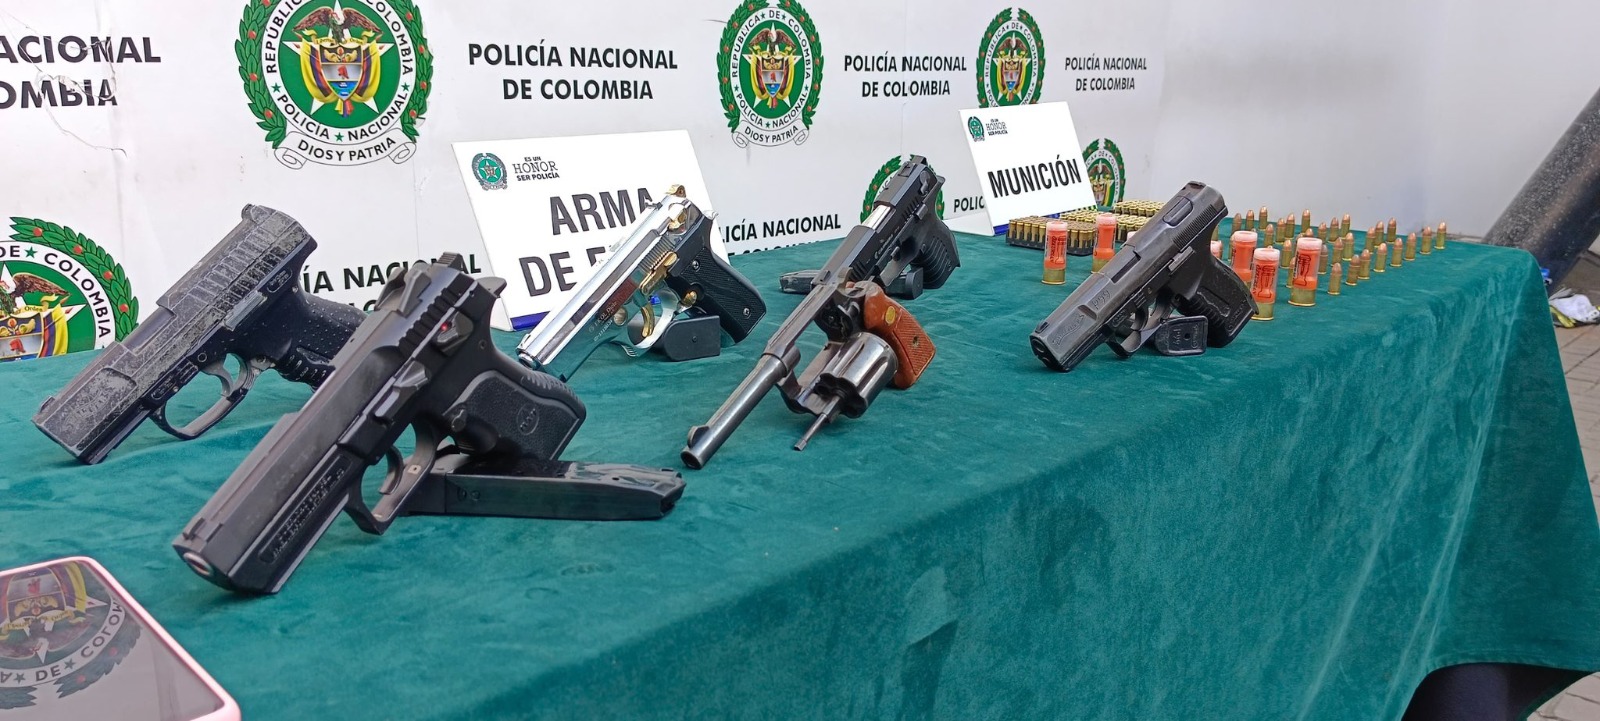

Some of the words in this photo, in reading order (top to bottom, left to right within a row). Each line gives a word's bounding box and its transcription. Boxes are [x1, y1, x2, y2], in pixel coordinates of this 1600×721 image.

[468, 39, 563, 67] POLICÍA
[570, 47, 678, 69] NACIONAL
[769, 10, 781, 19] DE
[788, 18, 811, 79] COLOMBIA
[844, 50, 898, 72] POLICÍA
[902, 55, 967, 72] NACIONAL
[1065, 52, 1101, 70] POLICÍA
[1103, 57, 1147, 70] NACIONAL
[503, 79, 532, 100] DE
[540, 79, 653, 100] COLOMBIA
[862, 81, 879, 97] DE
[883, 80, 950, 97] COLOMBIA
[1076, 78, 1088, 91] DE
[1090, 77, 1135, 91] COLOMBIA
[348, 92, 408, 142] NACIONAL
[772, 92, 808, 129] NACIONAL
[772, 125, 798, 143] PATRIA
[349, 137, 396, 161] PATRIA
[512, 161, 558, 174] HONOR
[987, 154, 1082, 198] MUNICIÓN
[763, 214, 841, 238] NACIONAL
[519, 251, 577, 297] DE
[44, 253, 111, 338] COLOMBIA
